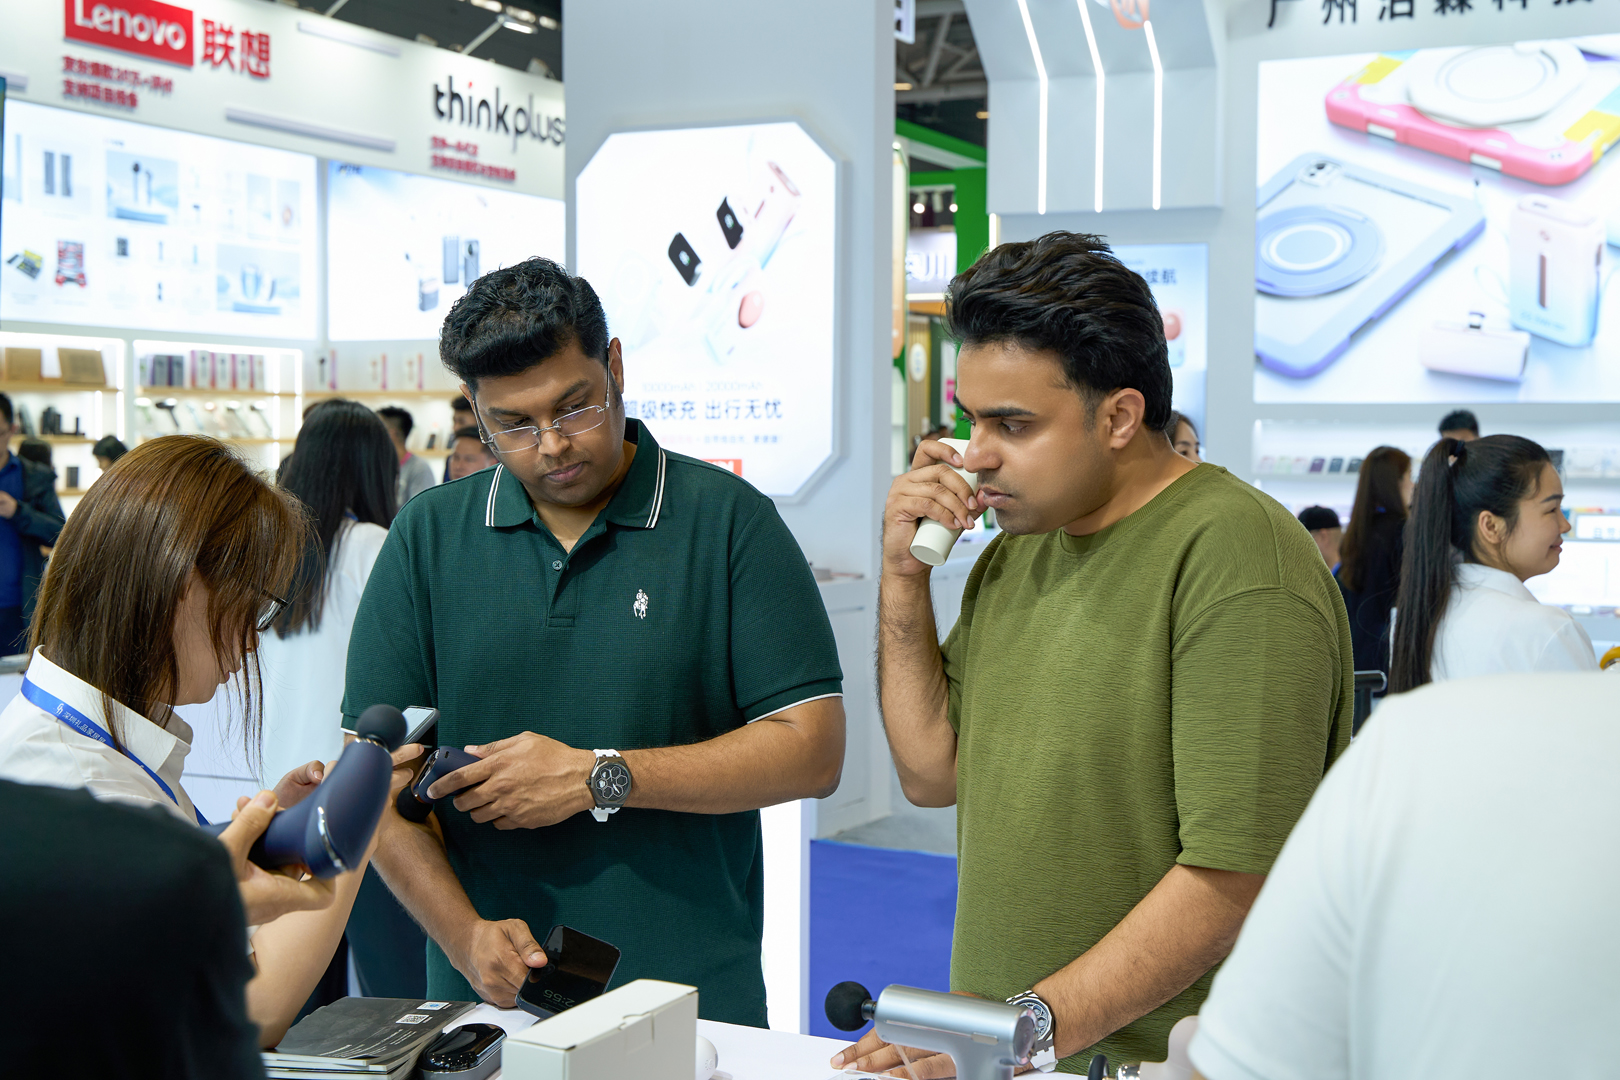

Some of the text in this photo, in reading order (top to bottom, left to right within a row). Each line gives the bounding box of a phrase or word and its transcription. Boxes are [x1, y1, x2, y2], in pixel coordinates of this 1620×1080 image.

[74, 0, 187, 50] Lenovo
[201, 18, 270, 78] 联想
[433, 75, 565, 153] thinkplus
[705, 398, 783, 420] 出行无忧
[543, 989, 575, 1008] 2:55
